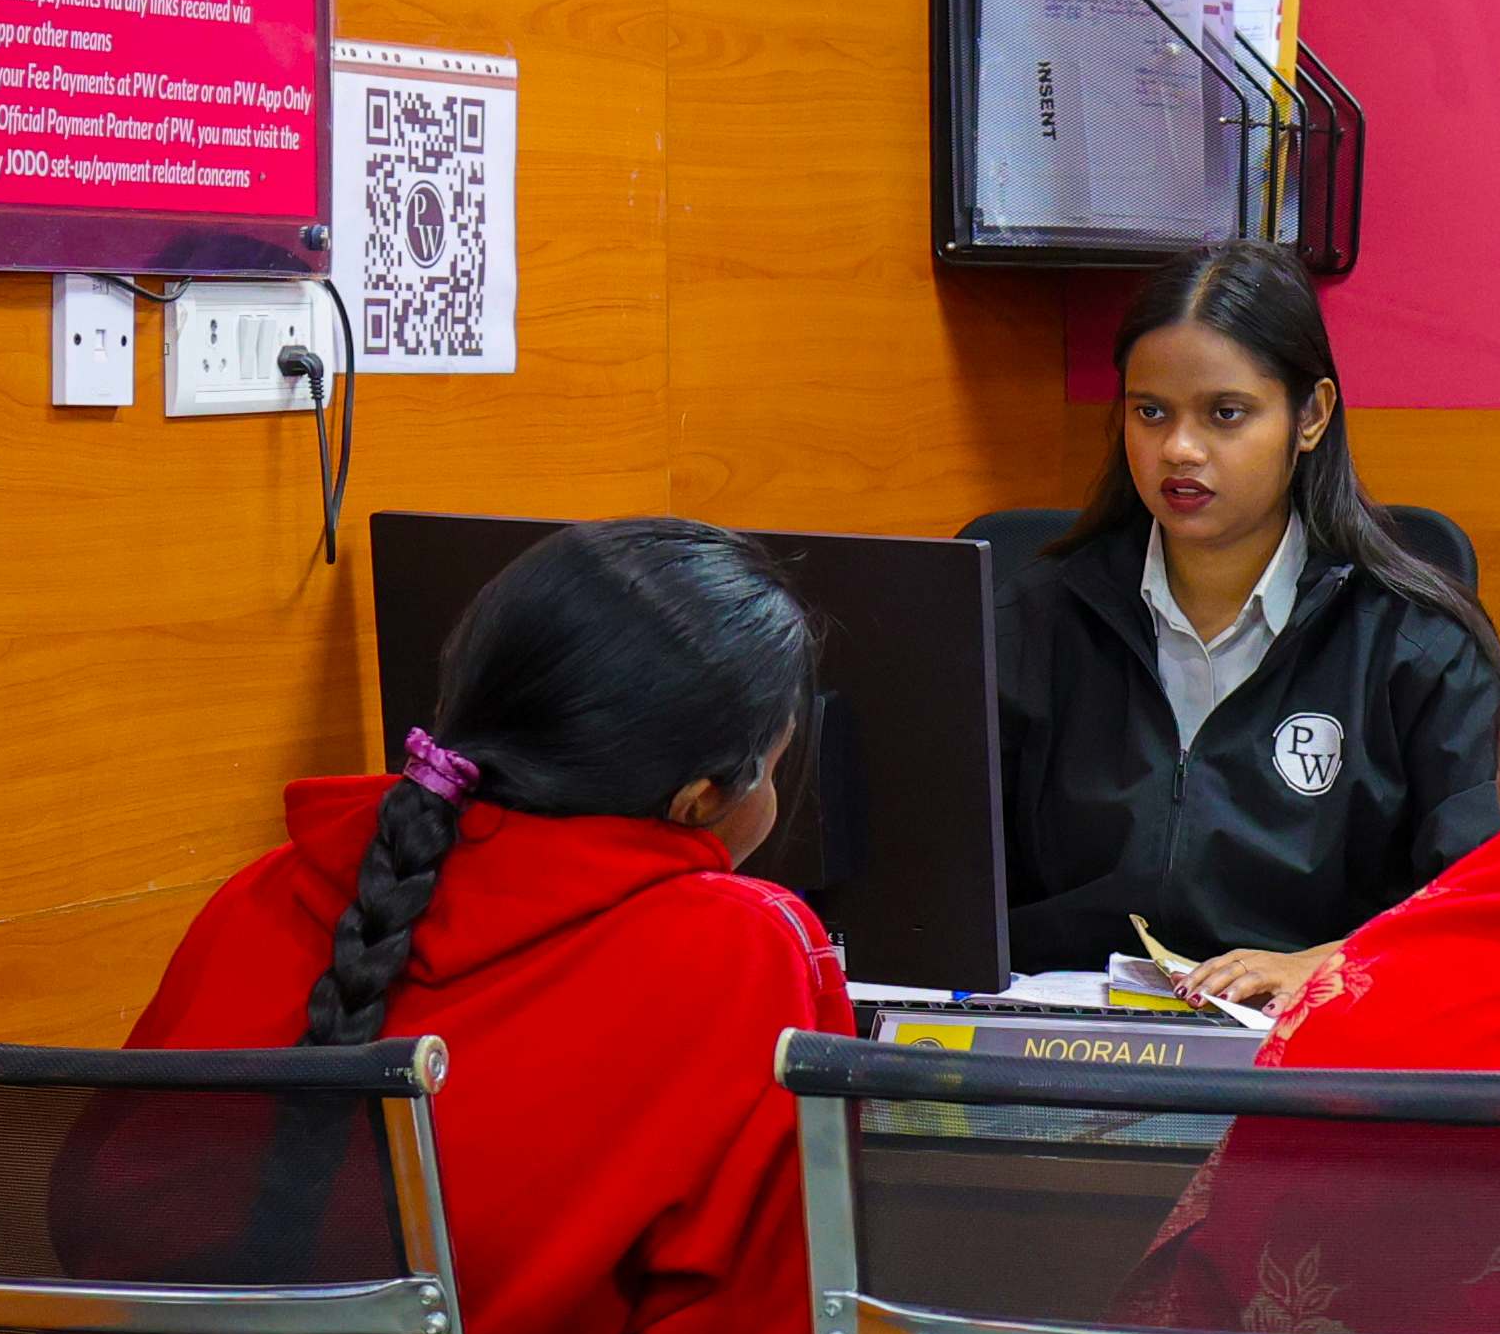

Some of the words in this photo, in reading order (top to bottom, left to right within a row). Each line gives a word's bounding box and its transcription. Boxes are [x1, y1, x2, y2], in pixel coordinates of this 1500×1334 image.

[27, 62, 51, 90] Fee
[52, 64, 116, 97] Payments
[116, 73, 132, 97] at
[132, 71, 157, 98] PW
[157, 74, 200, 102] Center
[200, 84, 216, 103] or
[215, 85, 232, 105] on
[233, 80, 257, 107] PW
[256, 82, 283, 113] App
[282, 84, 312, 116] Only
[47, 107, 105, 140] Payment
[105, 112, 155, 141] Partner
[155, 116, 170, 145] of
[170, 116, 196, 147] PW,
[197, 125, 221, 149] you
[221, 124, 253, 148] must
[252, 123, 280, 149] visit
[279, 124, 300, 151] the
[4, 148, 50, 177] JODO
[50, 154, 152, 186] set-up/payment
[152, 158, 196, 185] related
[197, 167, 251, 188] concerns
[1023, 1036, 1131, 1065] NOORA
[1138, 1042, 1185, 1067] ALI
